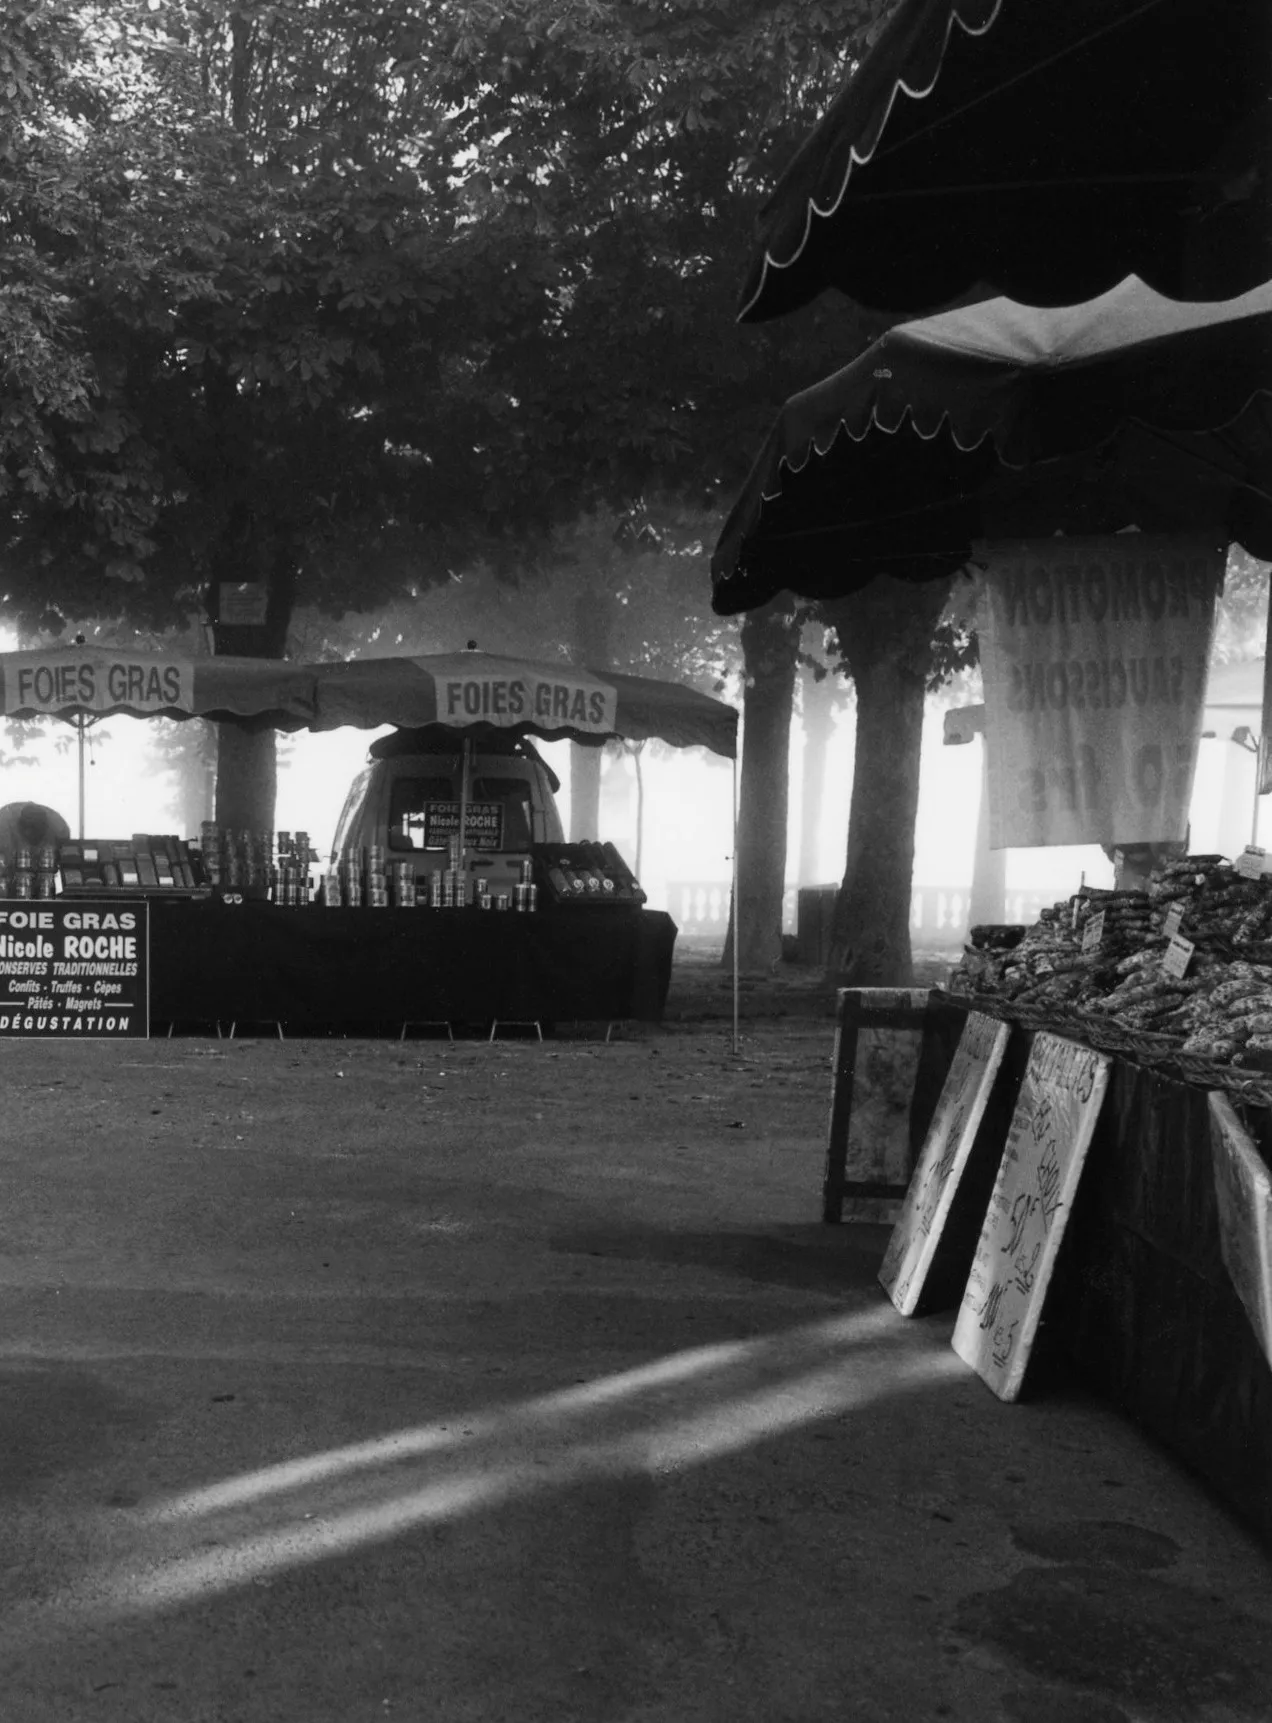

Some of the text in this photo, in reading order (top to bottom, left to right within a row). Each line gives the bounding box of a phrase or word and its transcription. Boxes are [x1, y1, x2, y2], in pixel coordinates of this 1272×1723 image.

[18, 664, 180, 704] FOIES GRAS
[447, 681, 606, 724] FOIES GRAS
[430, 814, 498, 828] Nicole ROCHE
[63, 912, 136, 930] GRAS
[63, 935, 137, 959] ROCHE
[52, 962, 138, 976] TRADITIONNELLES
[8, 979, 122, 996] Confits Truffes Cèpes
[27, 996, 102, 1012] Pâtés Magrets
[0, 1013, 129, 1031] DÉGUSTATION
